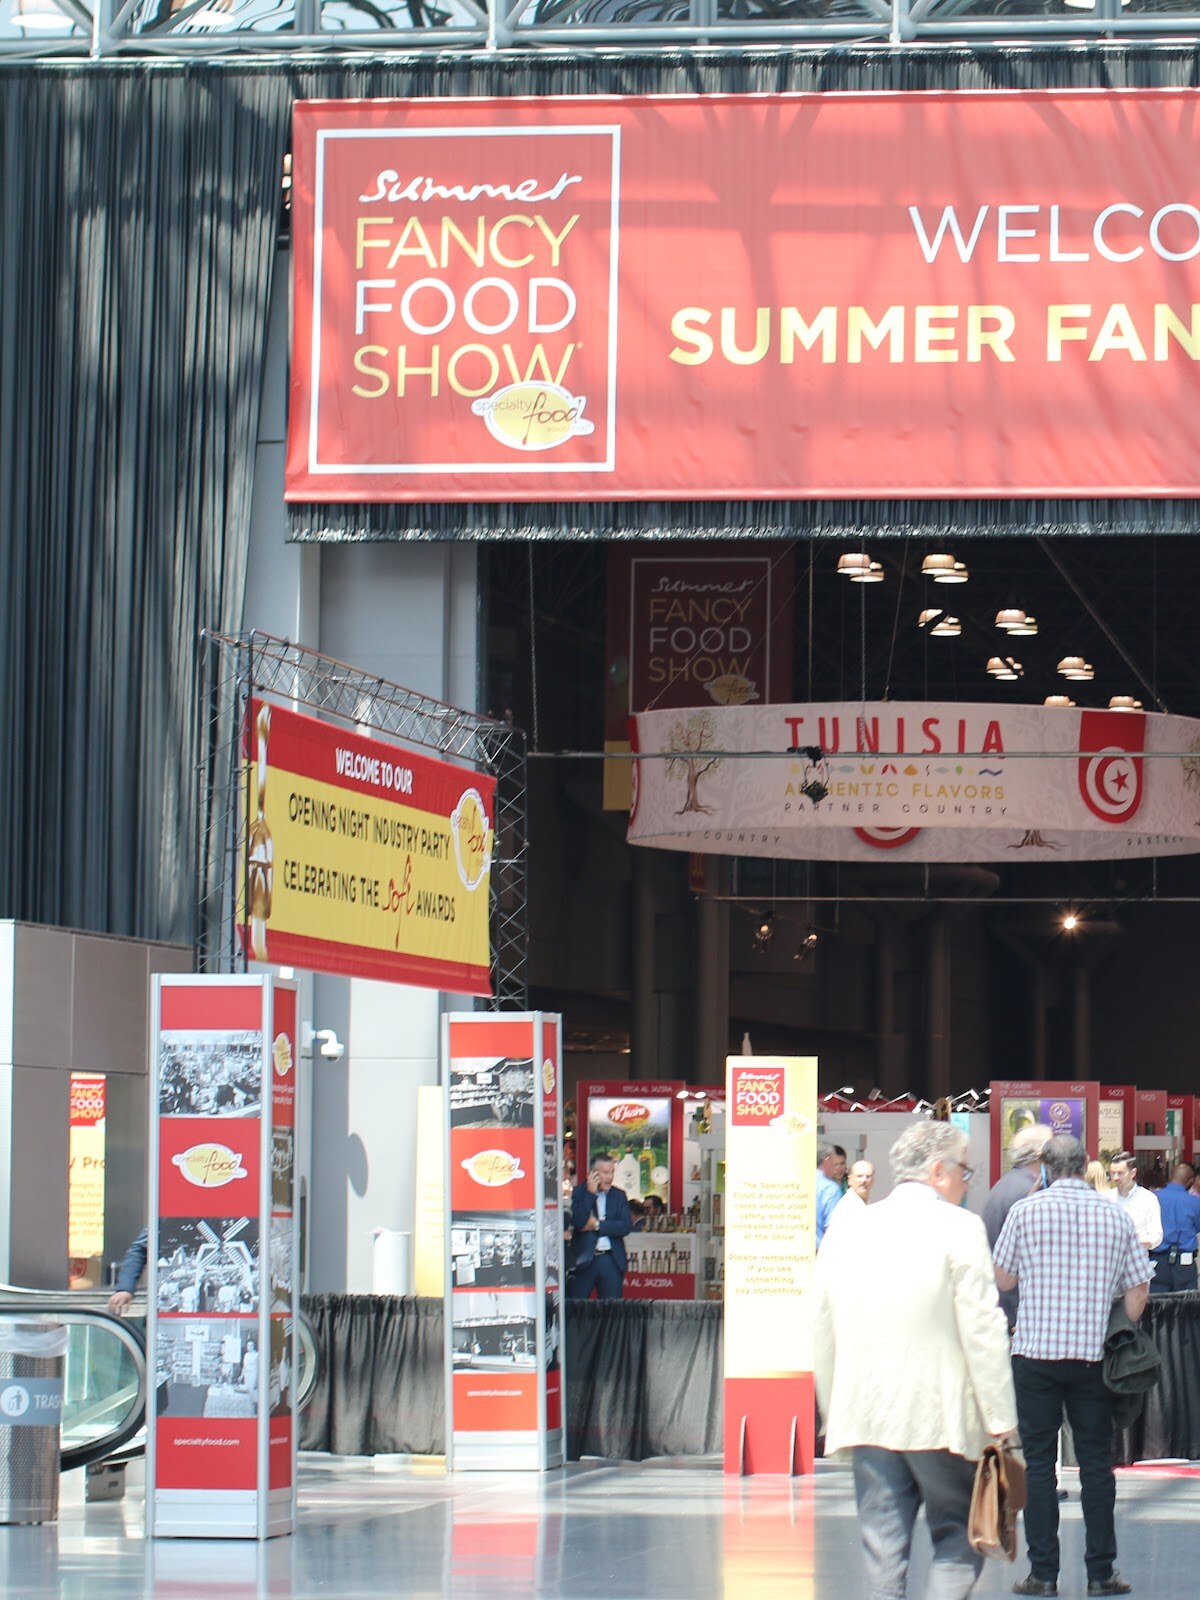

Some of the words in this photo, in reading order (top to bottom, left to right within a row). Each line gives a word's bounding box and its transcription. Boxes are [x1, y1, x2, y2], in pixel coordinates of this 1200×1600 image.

[359, 168, 583, 204] Summer
[355, 214, 580, 270] FANCY
[355, 276, 577, 336] FOOD
[668, 304, 1016, 366] SUMMER
[522, 392, 581, 446] food
[651, 577, 753, 593] Summer
[649, 599, 752, 623] FANCY
[649, 627, 752, 653] FOOD
[648, 656, 750, 682] SHOW
[784, 717, 1006, 759] TUNISIA
[335, 747, 380, 785] WELCOME
[381, 761, 393, 788] TO
[394, 765, 413, 795] OUR
[912, 783, 1005, 800] FLAVORS
[784, 803, 880, 814] PARTNER
[902, 804, 1007, 816] COUNTRY
[288, 792, 337, 832] OPENING
[338, 806, 370, 841] NIGHT
[373, 815, 420, 853] INDUSTRY
[421, 828, 450, 861] PARTY
[283, 859, 357, 903] CELEBRATING
[360, 876, 379, 907] THE
[416, 889, 456, 923] AWARDS
[736, 1080, 780, 1092] FANCY
[736, 1092, 780, 1105] FOOD
[736, 1104, 780, 1116] SHOW
[33, 1394, 61, 1409] TRAS
[174, 1437, 240, 1447] specialtyfood.com
